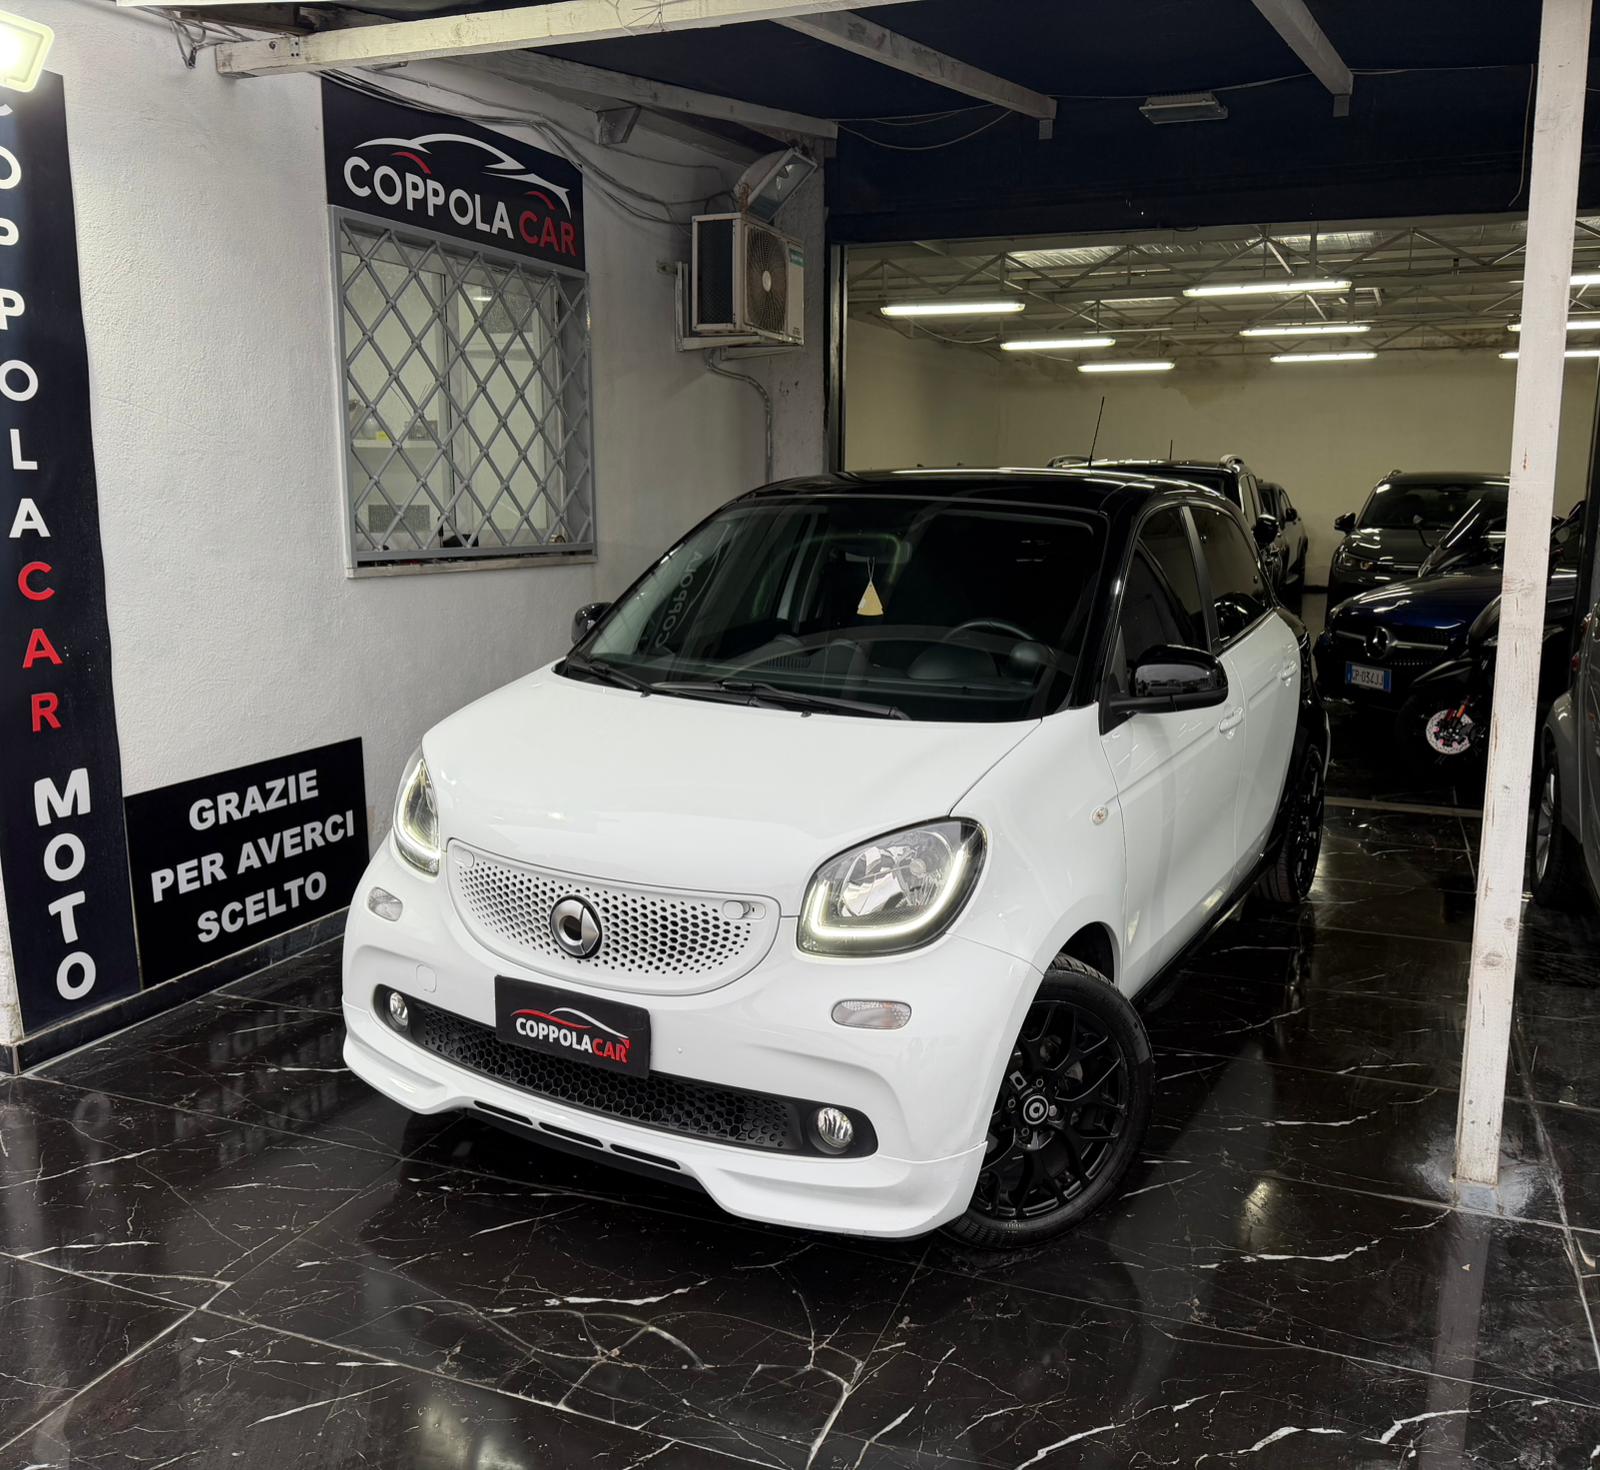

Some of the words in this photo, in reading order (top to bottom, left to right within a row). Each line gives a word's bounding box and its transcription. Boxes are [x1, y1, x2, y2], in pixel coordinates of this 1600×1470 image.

[343, 156, 515, 240] COPPOLA
[519, 210, 577, 256] CAR
[0, 104, 51, 538] OPPOLA
[17, 561, 63, 732] CAR
[189, 769, 319, 831] GRAZIE
[34, 767, 97, 1000] MOTO
[151, 852, 227, 903] PER
[237, 809, 354, 875] AVERCI
[197, 871, 327, 943] SCELTO
